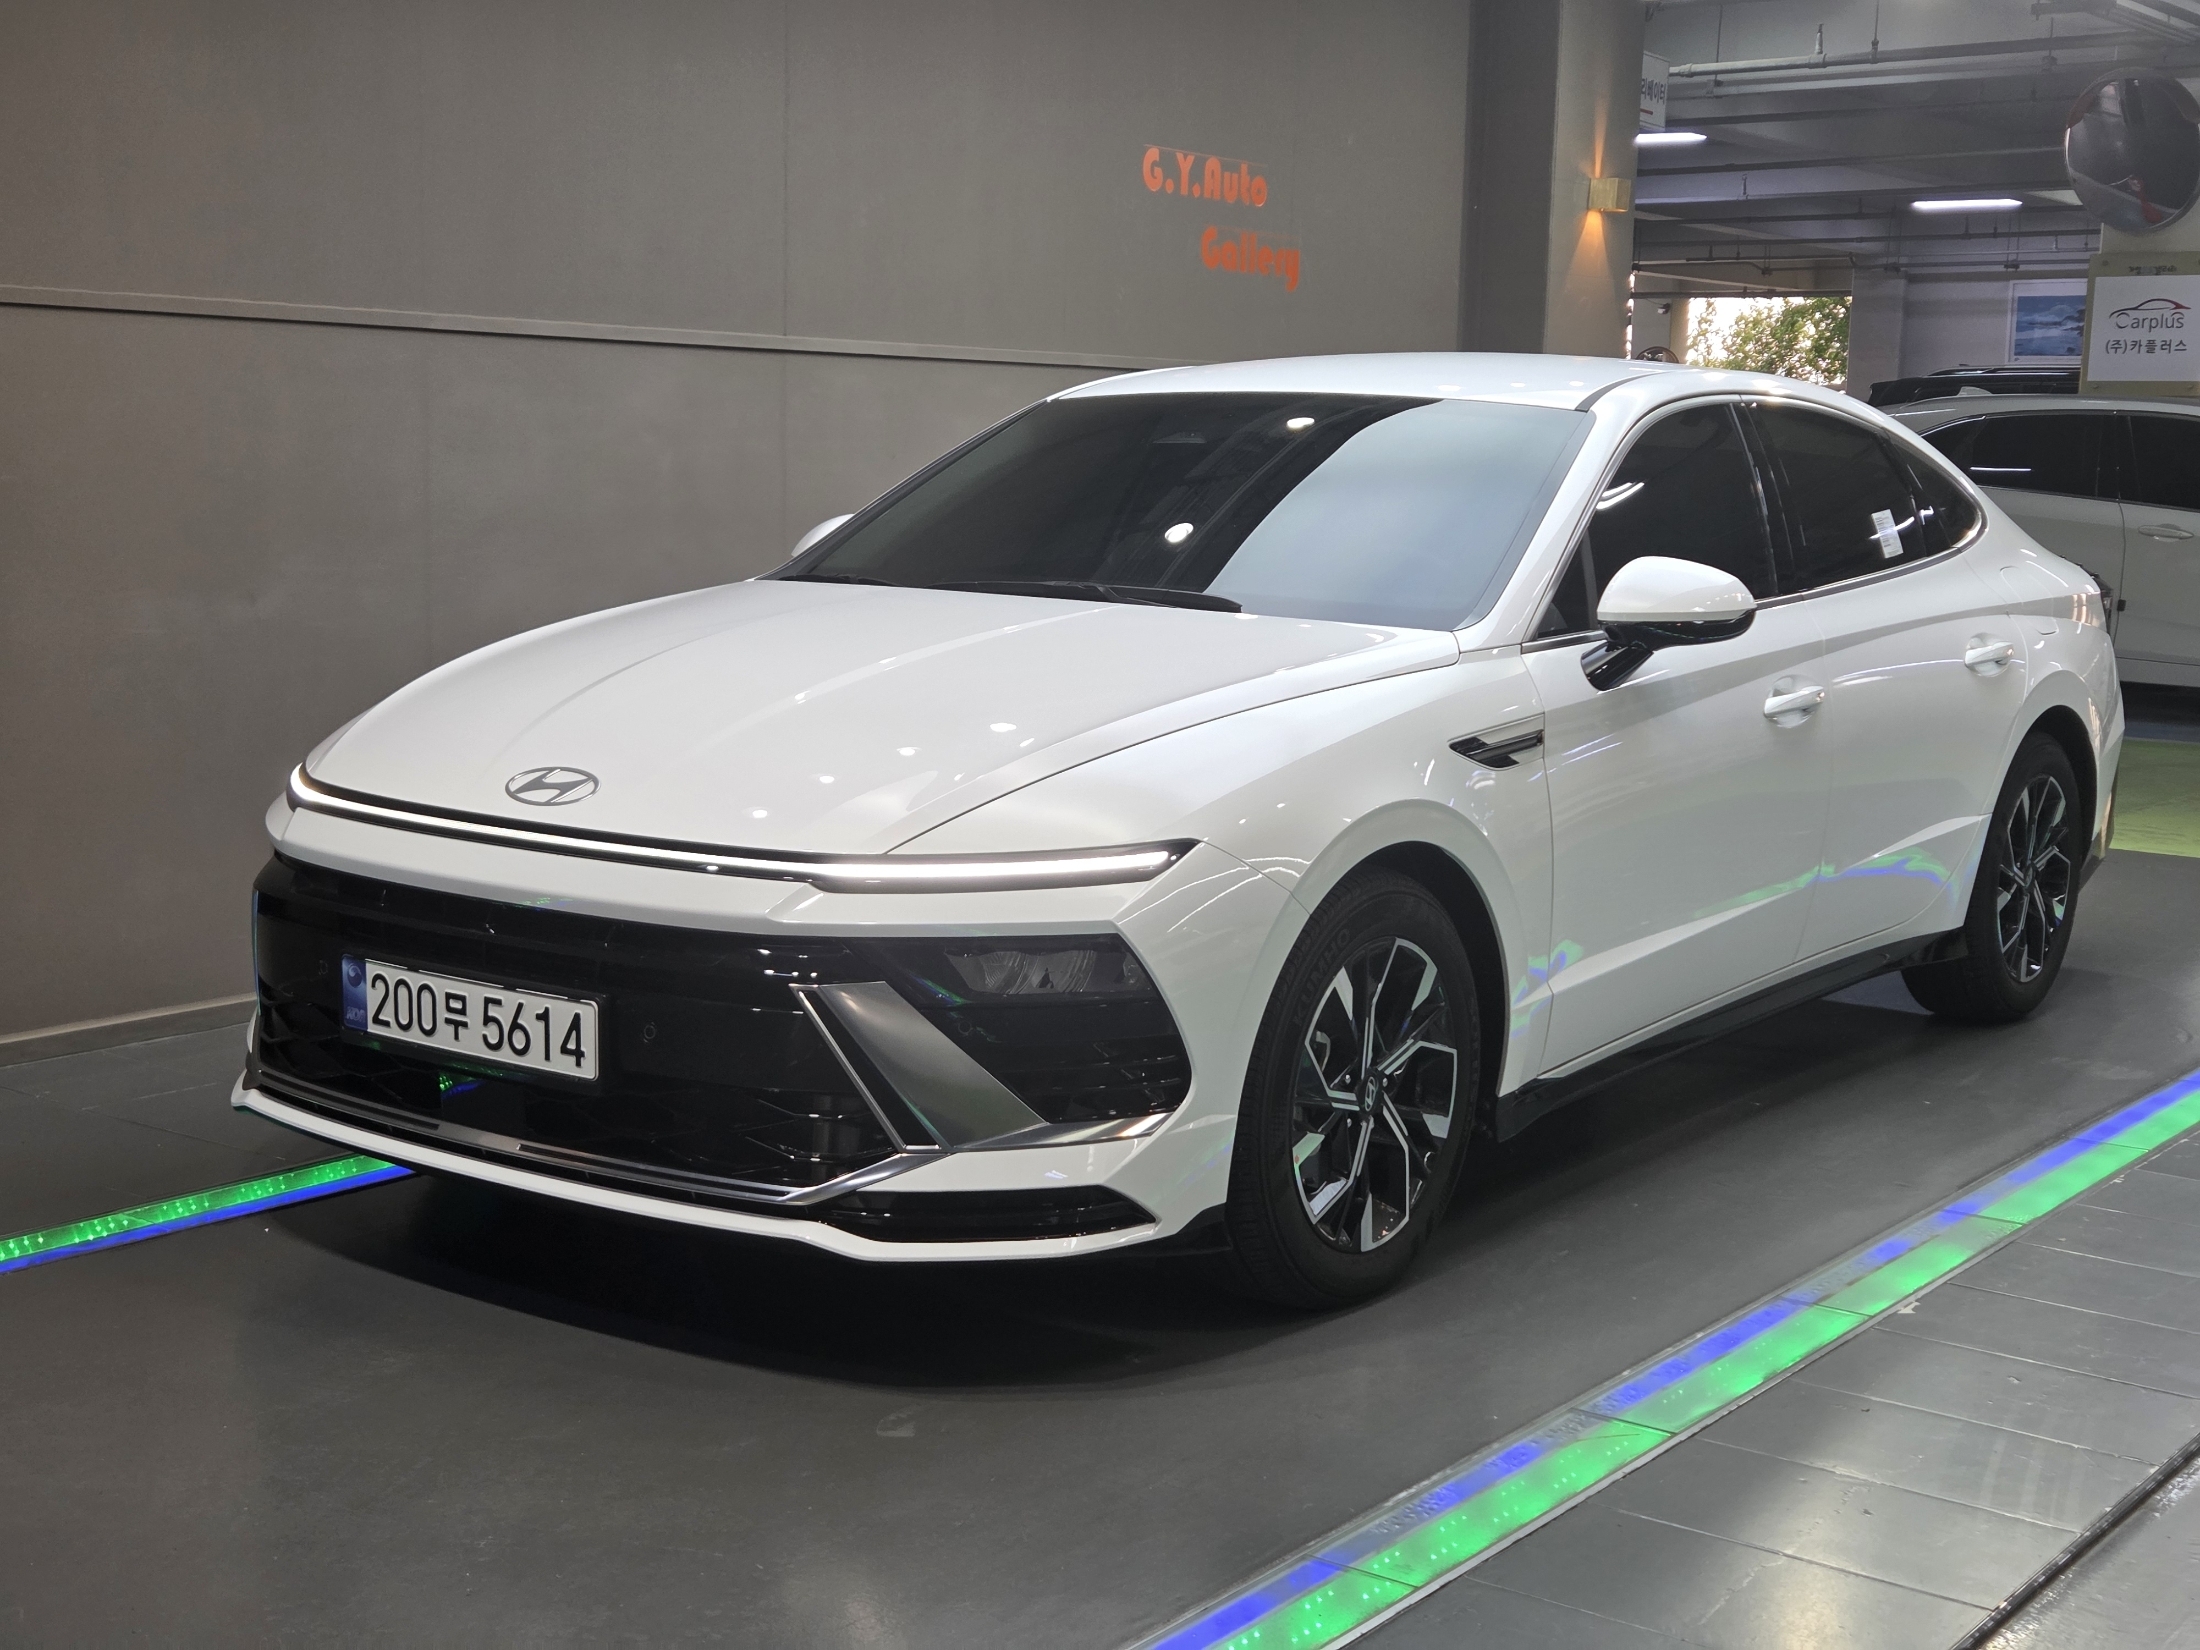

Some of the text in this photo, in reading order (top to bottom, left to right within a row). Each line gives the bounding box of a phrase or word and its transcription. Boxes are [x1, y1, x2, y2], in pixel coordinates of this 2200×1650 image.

[1142, 147, 1268, 207] G.Y.Auto
[1202, 226, 1300, 292] Gallery
[2105, 339, 2188, 354] (주)카플러스
[2115, 311, 2185, 333] Carplus
[482, 994, 586, 1068] 5614
